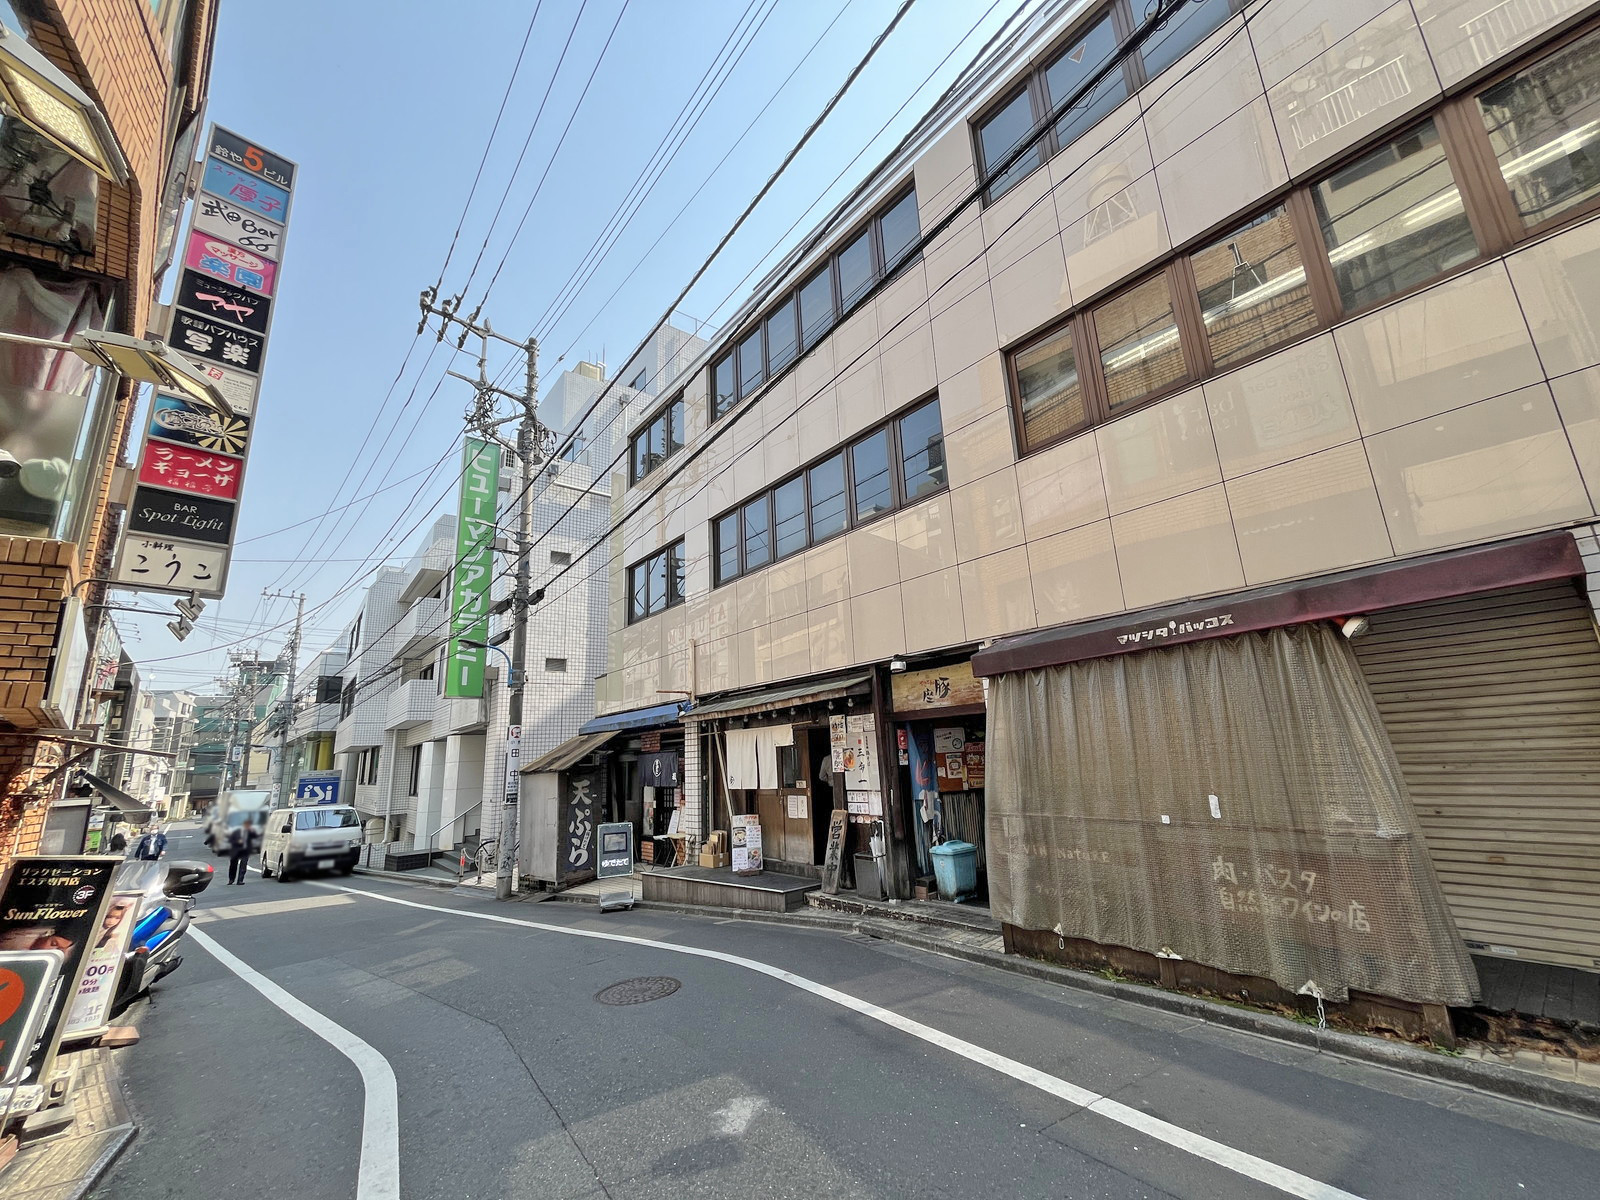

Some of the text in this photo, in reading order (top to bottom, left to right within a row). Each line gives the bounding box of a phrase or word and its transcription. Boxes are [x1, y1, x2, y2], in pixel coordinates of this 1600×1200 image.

[155, 447, 235, 472] ラーメン
[151, 461, 235, 487] ギョーザ
[174, 502, 198, 514] BAR
[138, 507, 225, 531] Spot Light
[456, 449, 492, 686] ヒューマンアカデミー
[1179, 613, 1234, 634] バッコス
[568, 779, 592, 867] 天ぷら
[17, 877, 81, 886] エステ専門店
[22, 868, 103, 877] リラクゼーション
[76, 890, 95, 900] 3F
[4, 908, 88, 921] SunFlower
